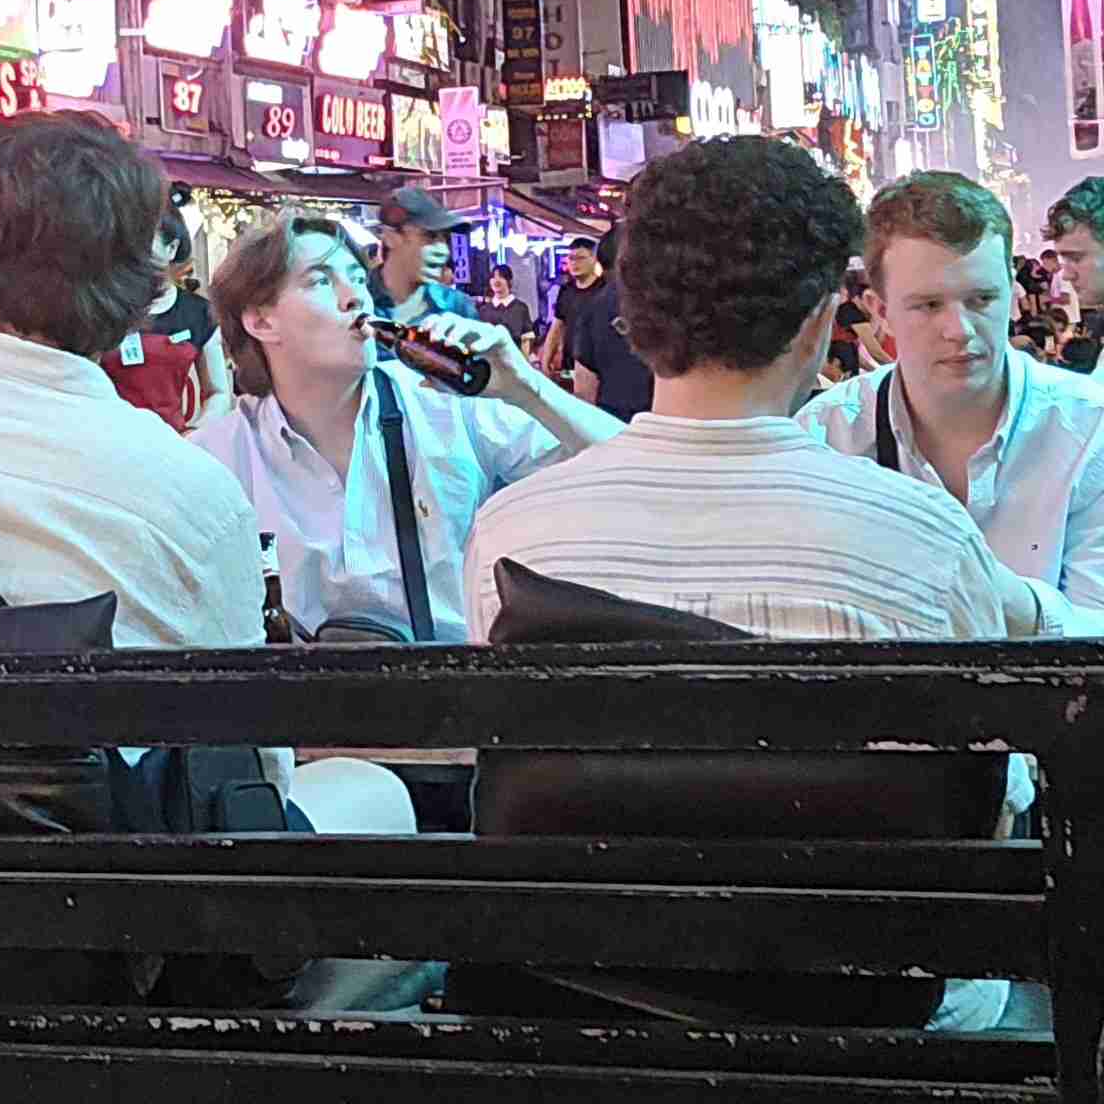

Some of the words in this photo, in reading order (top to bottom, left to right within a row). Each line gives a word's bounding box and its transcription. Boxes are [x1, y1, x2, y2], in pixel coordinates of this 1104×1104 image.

[173, 80, 202, 113] 87
[267, 106, 296, 139] 89
[323, 93, 354, 136] COLD
[356, 100, 385, 142] BEER
